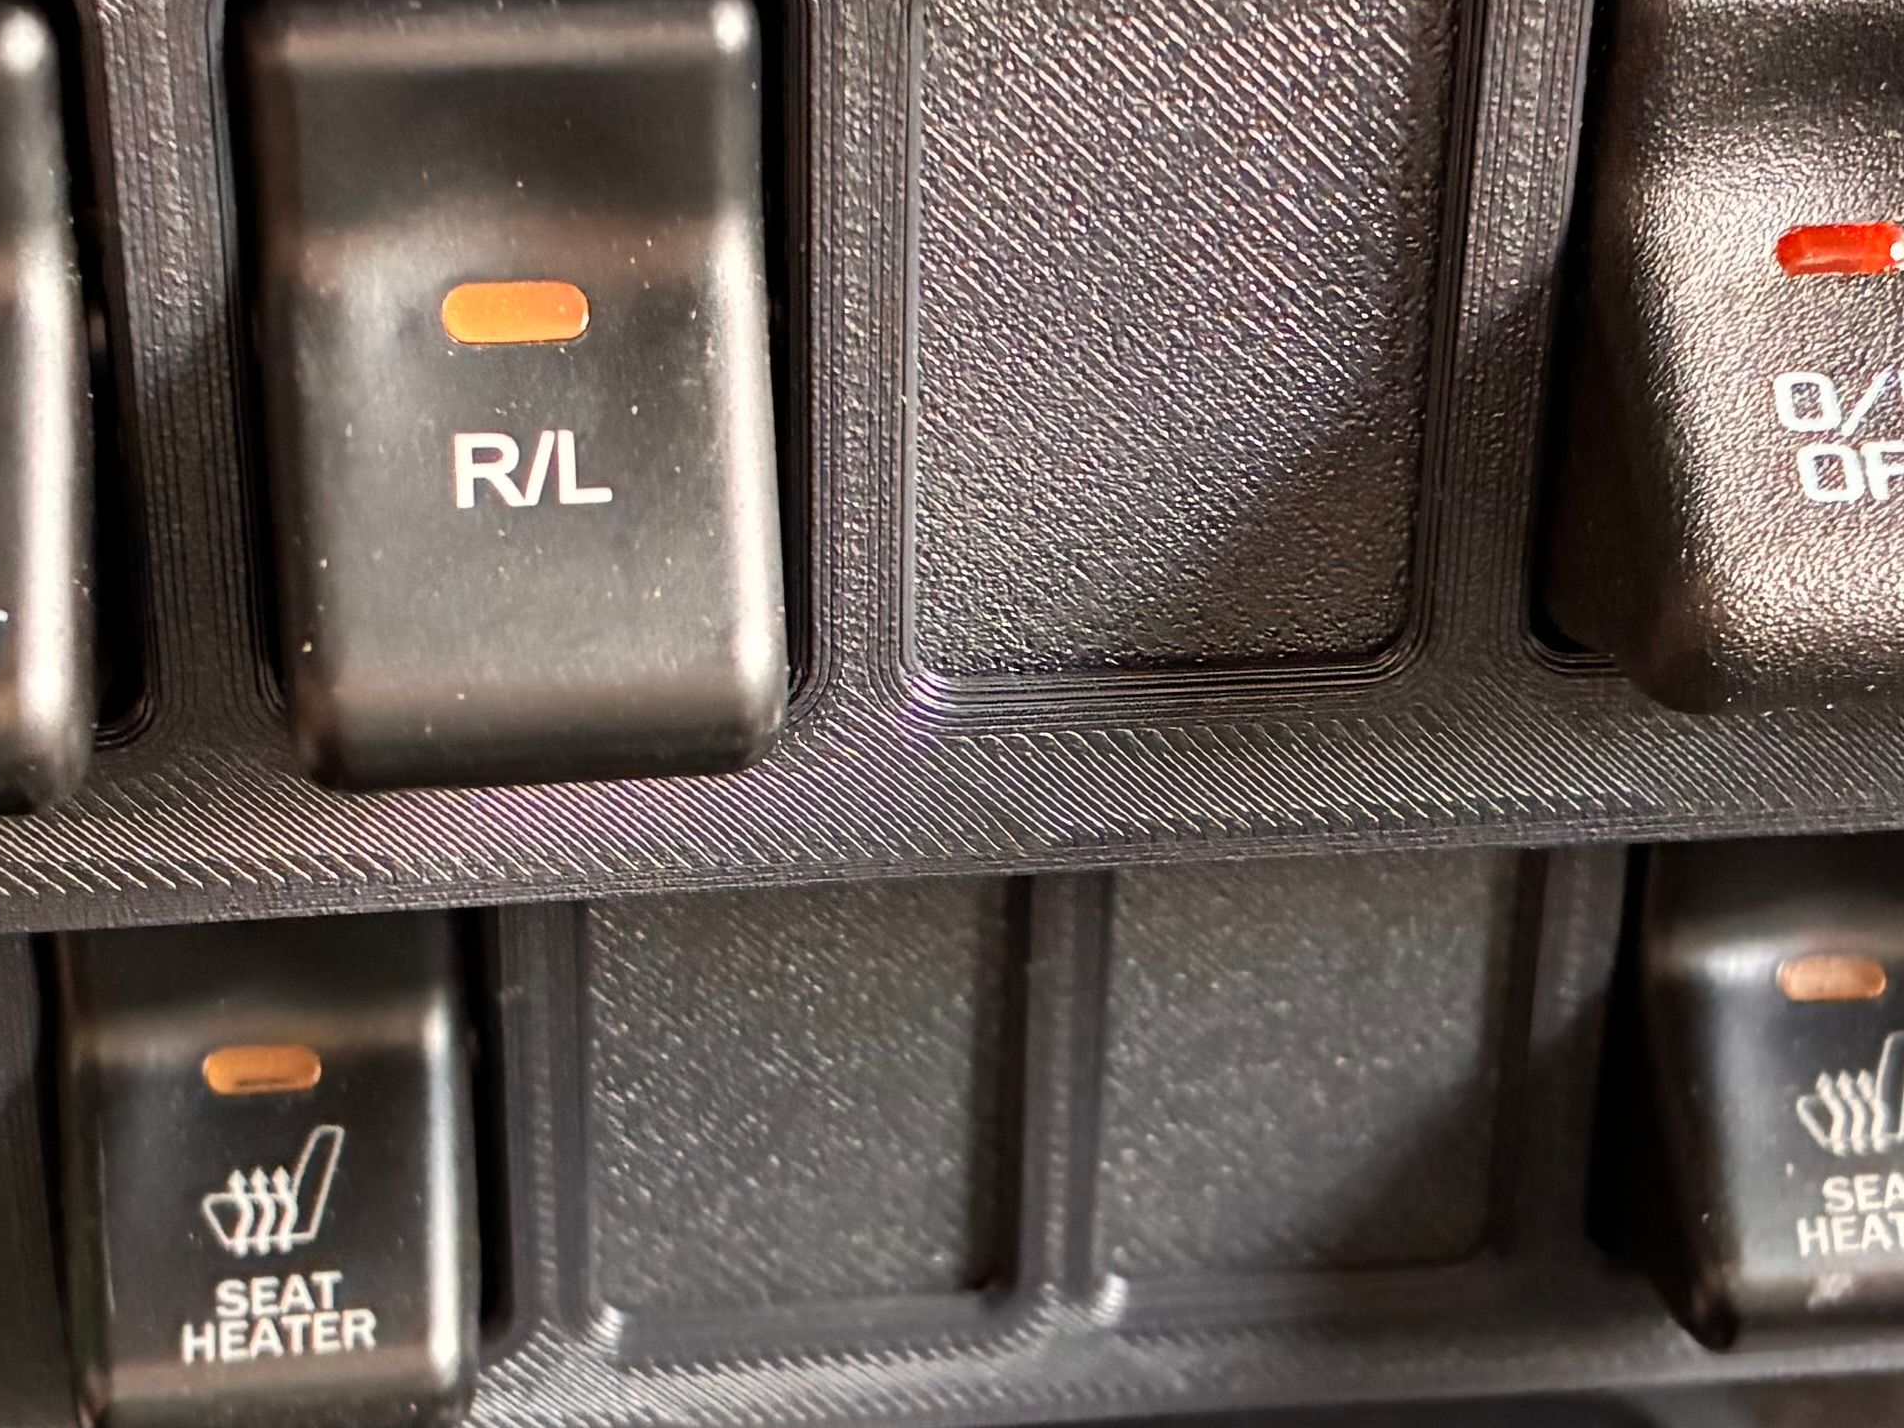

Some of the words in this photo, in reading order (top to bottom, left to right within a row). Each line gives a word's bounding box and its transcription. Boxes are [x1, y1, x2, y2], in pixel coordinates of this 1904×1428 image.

[453, 429, 614, 509] R/L
[215, 1270, 343, 1318] SEAT
[181, 1308, 377, 1365] HEATER
